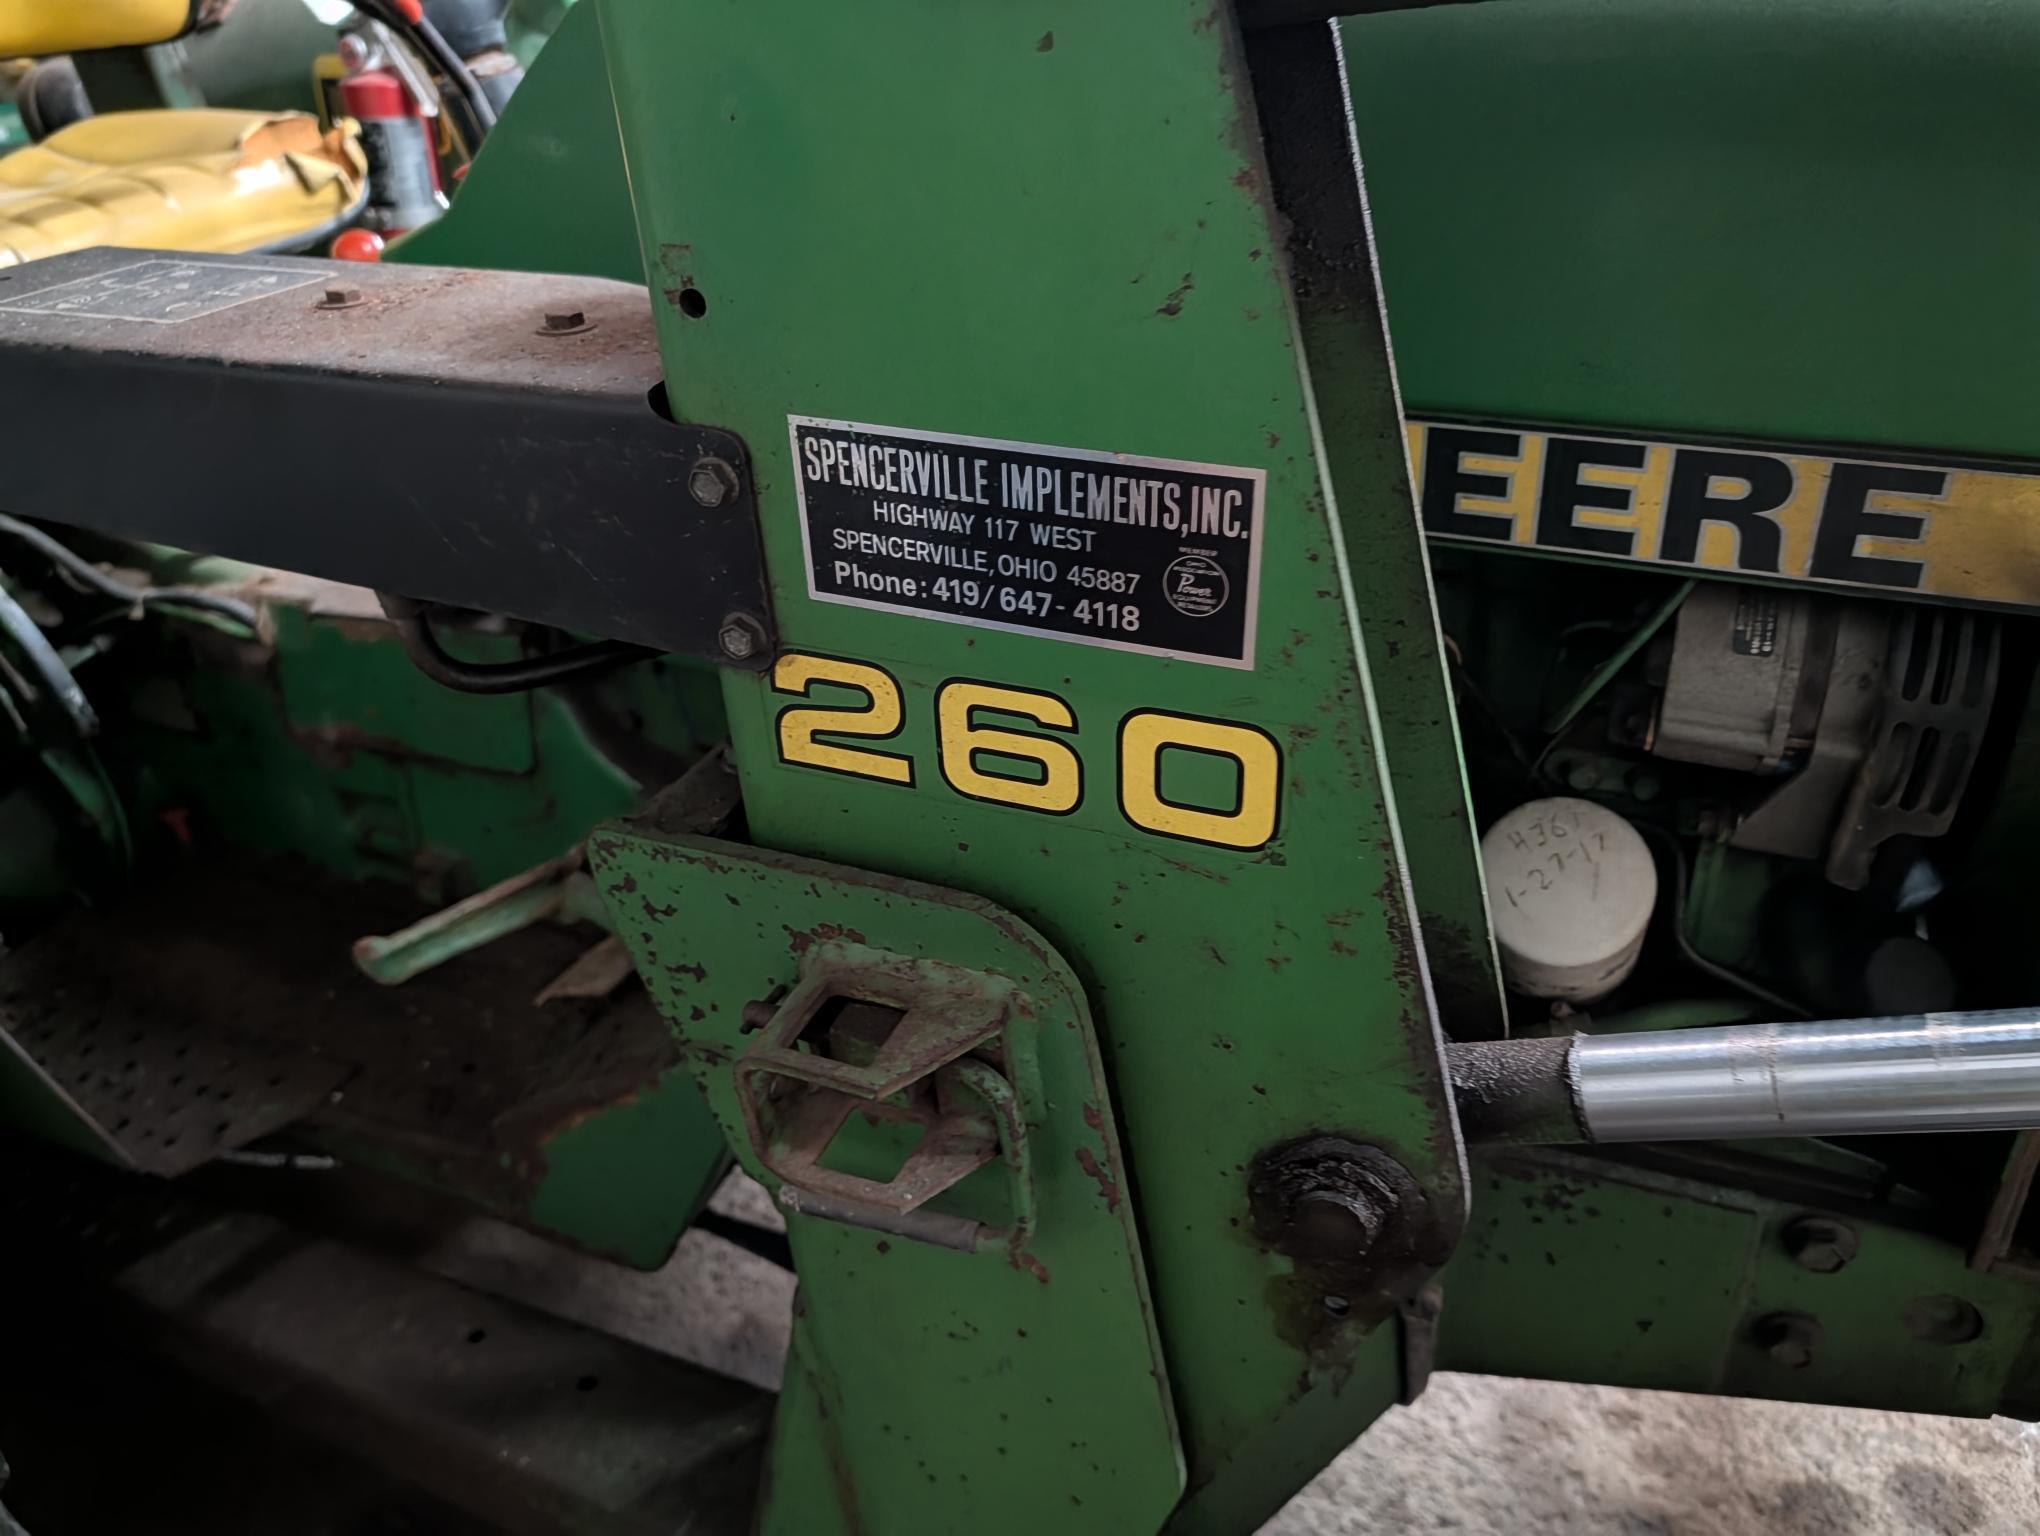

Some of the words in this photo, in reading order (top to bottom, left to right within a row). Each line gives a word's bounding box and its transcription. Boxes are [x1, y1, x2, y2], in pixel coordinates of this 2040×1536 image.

[804, 436, 990, 505] SPENCERVILLE
[873, 500, 976, 535] HIGHWAY
[984, 516, 1020, 541] 117
[1029, 522, 1098, 552] WEST
[834, 560, 927, 598] Phone:
[1066, 564, 1141, 595] 45887
[772, 648, 1283, 852] 260
